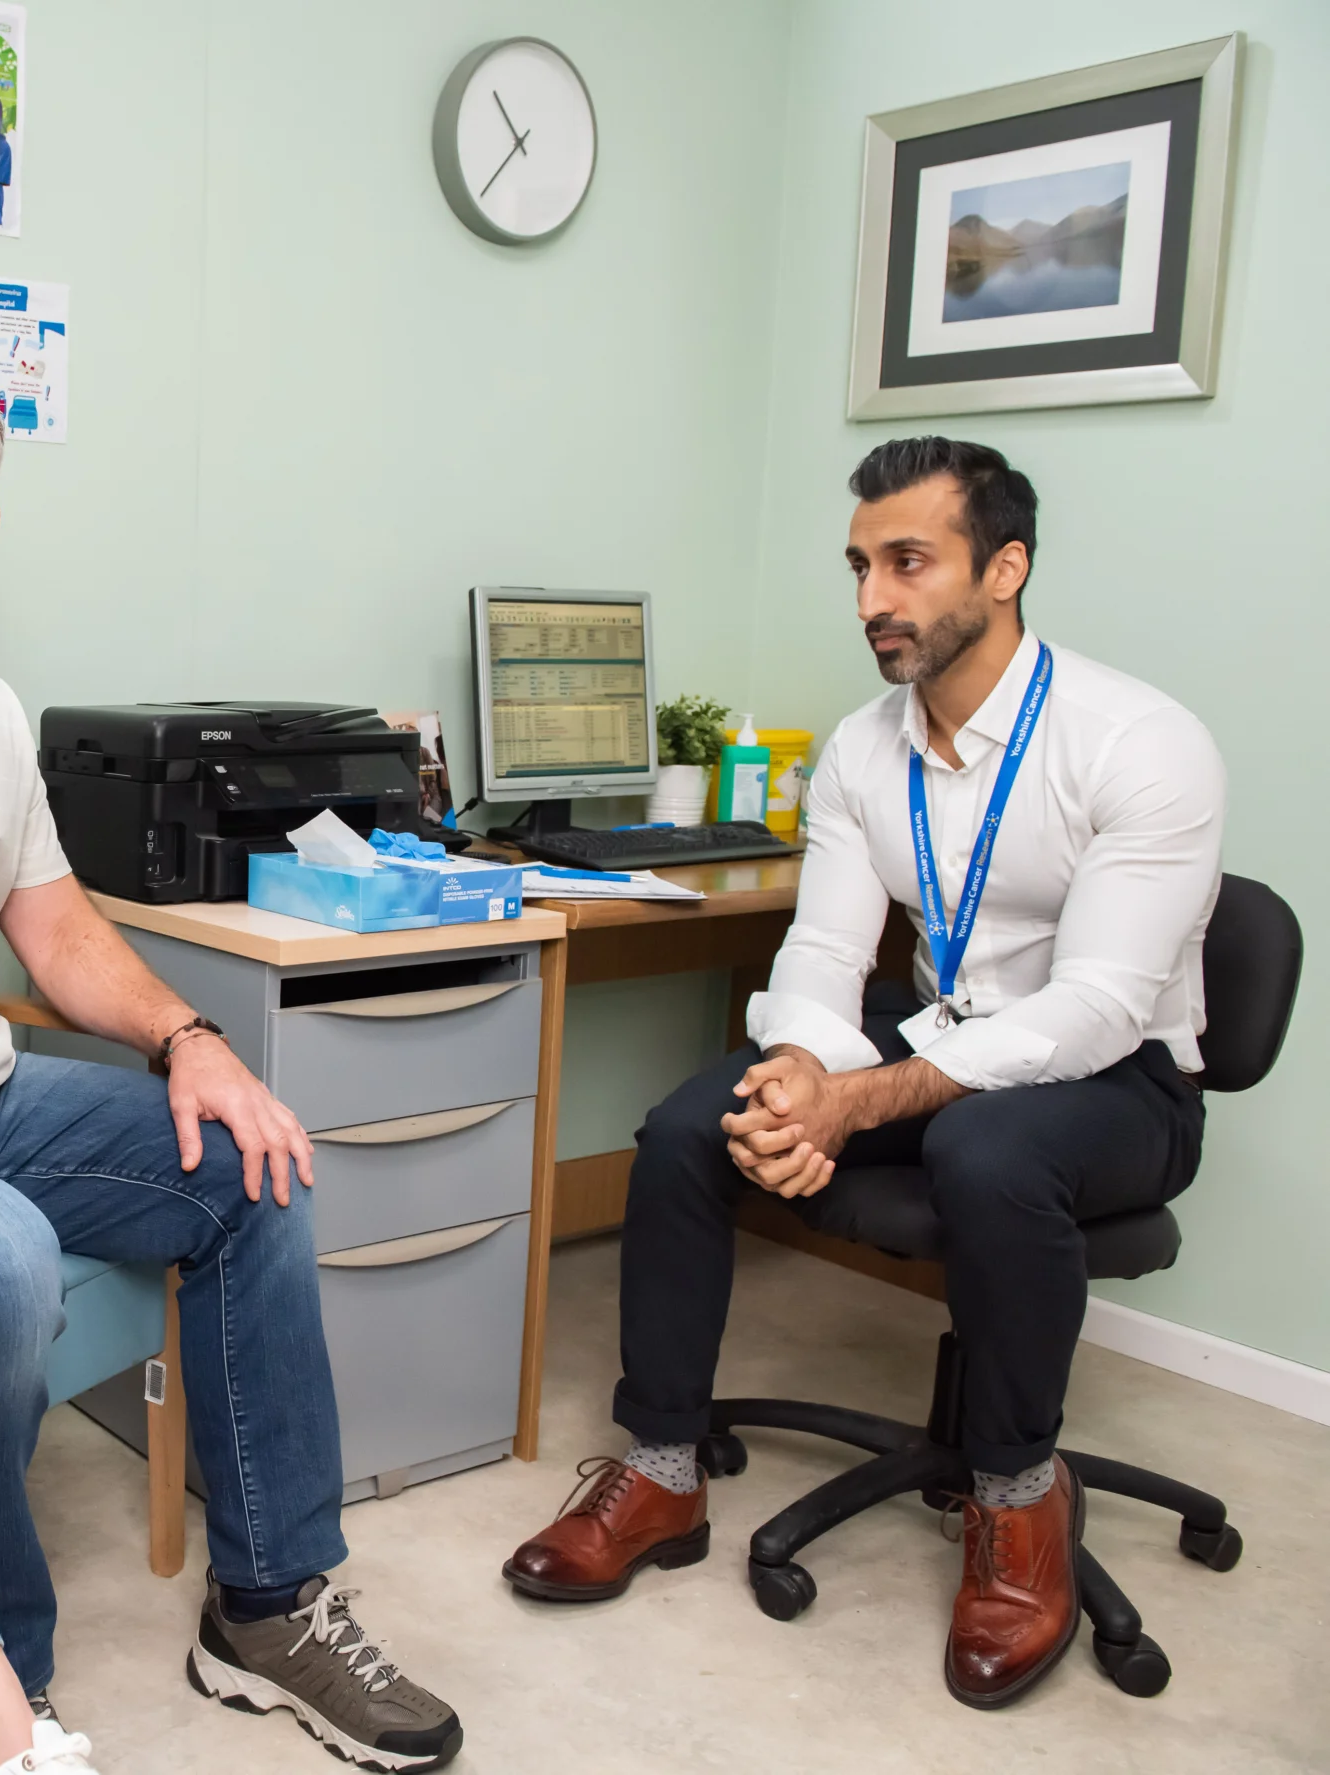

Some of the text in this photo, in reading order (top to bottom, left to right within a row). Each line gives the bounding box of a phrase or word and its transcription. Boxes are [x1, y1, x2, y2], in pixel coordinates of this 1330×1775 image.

[201, 731, 231, 740] EPSON
[1010, 715, 1032, 757] Yorkshire
[1026, 684, 1043, 715] Cancer
[914, 810, 938, 922] Yorkshire Cancer Research
[956, 828, 993, 938] Yorkshire Cancer Research
[491, 902, 516, 912] 100 M
